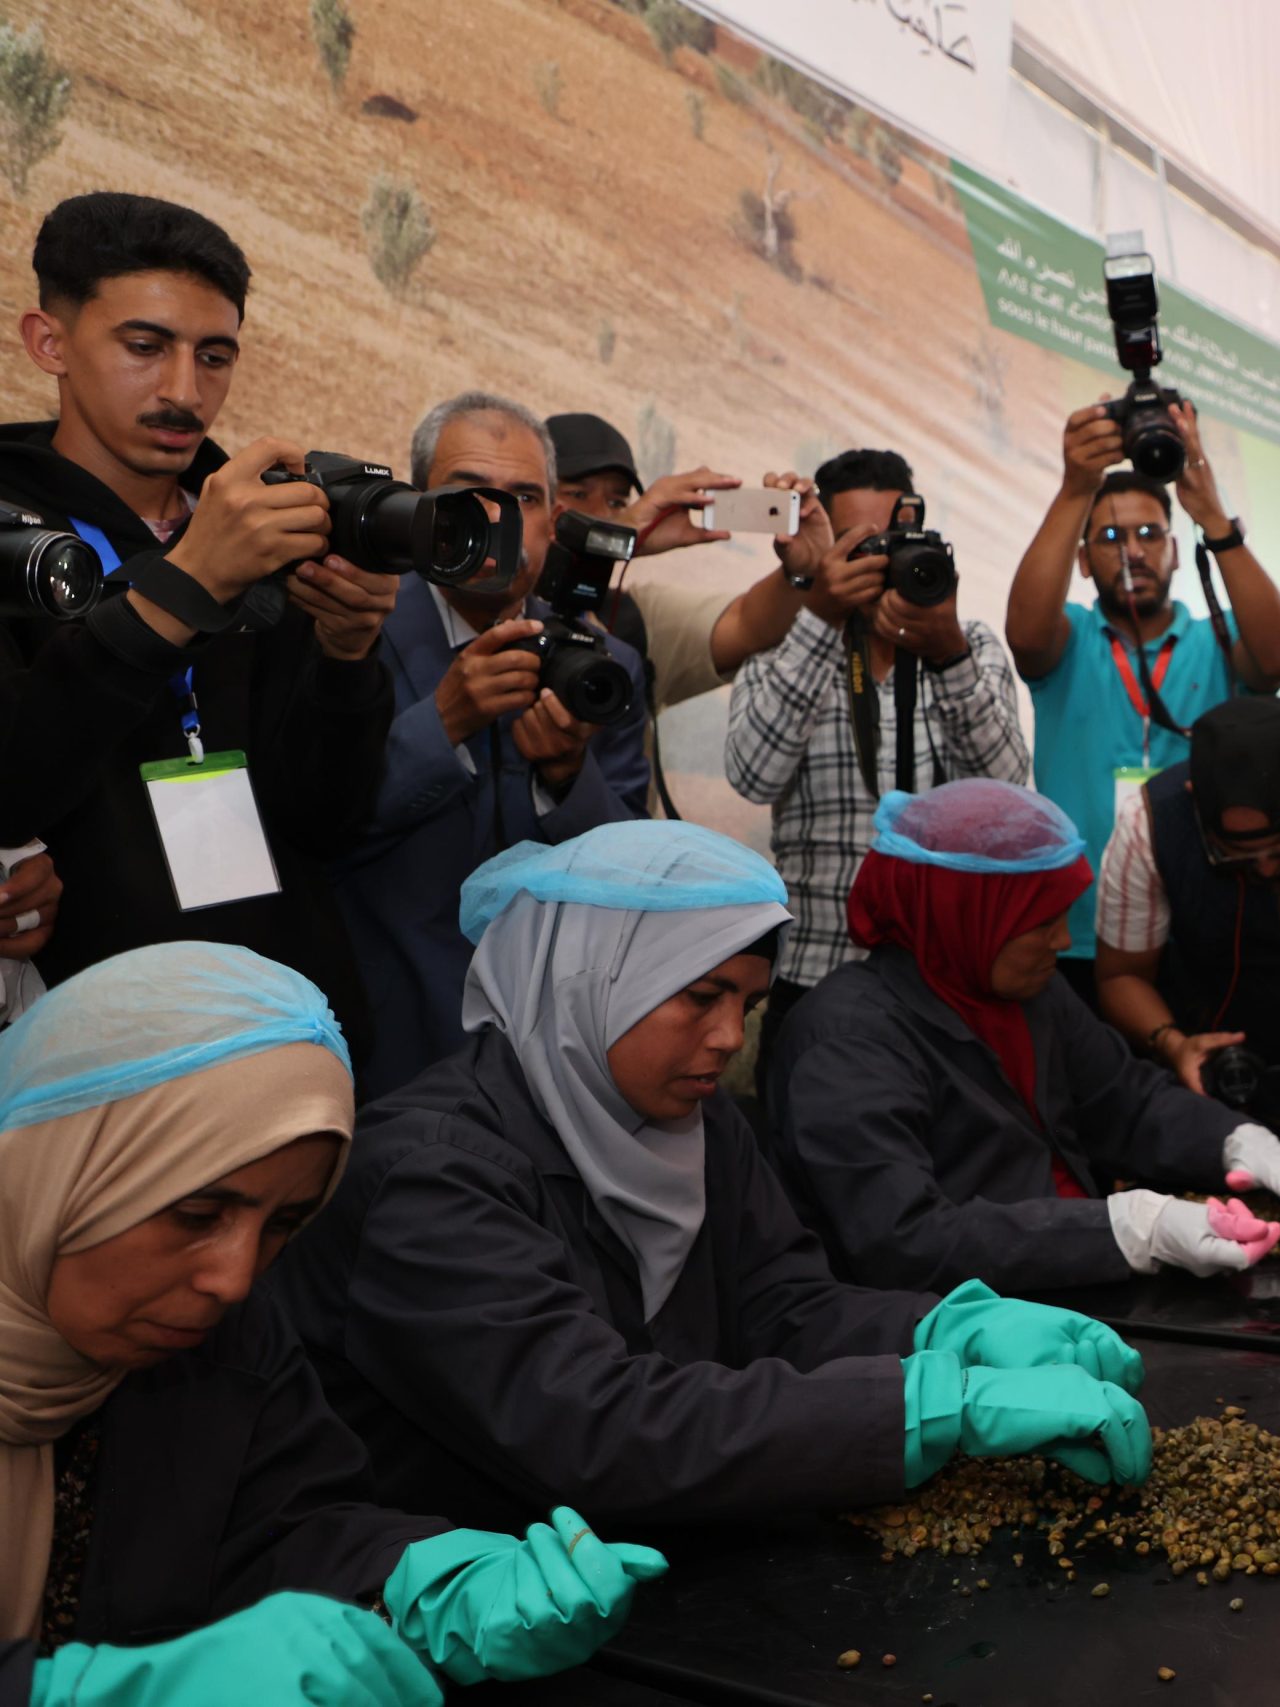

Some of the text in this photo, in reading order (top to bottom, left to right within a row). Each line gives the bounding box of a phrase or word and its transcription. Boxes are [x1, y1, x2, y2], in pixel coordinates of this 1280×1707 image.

[998, 297, 1119, 361] sous le haut patro
[364, 465, 390, 476] LUMIX
[21, 513, 42, 525] Nikon
